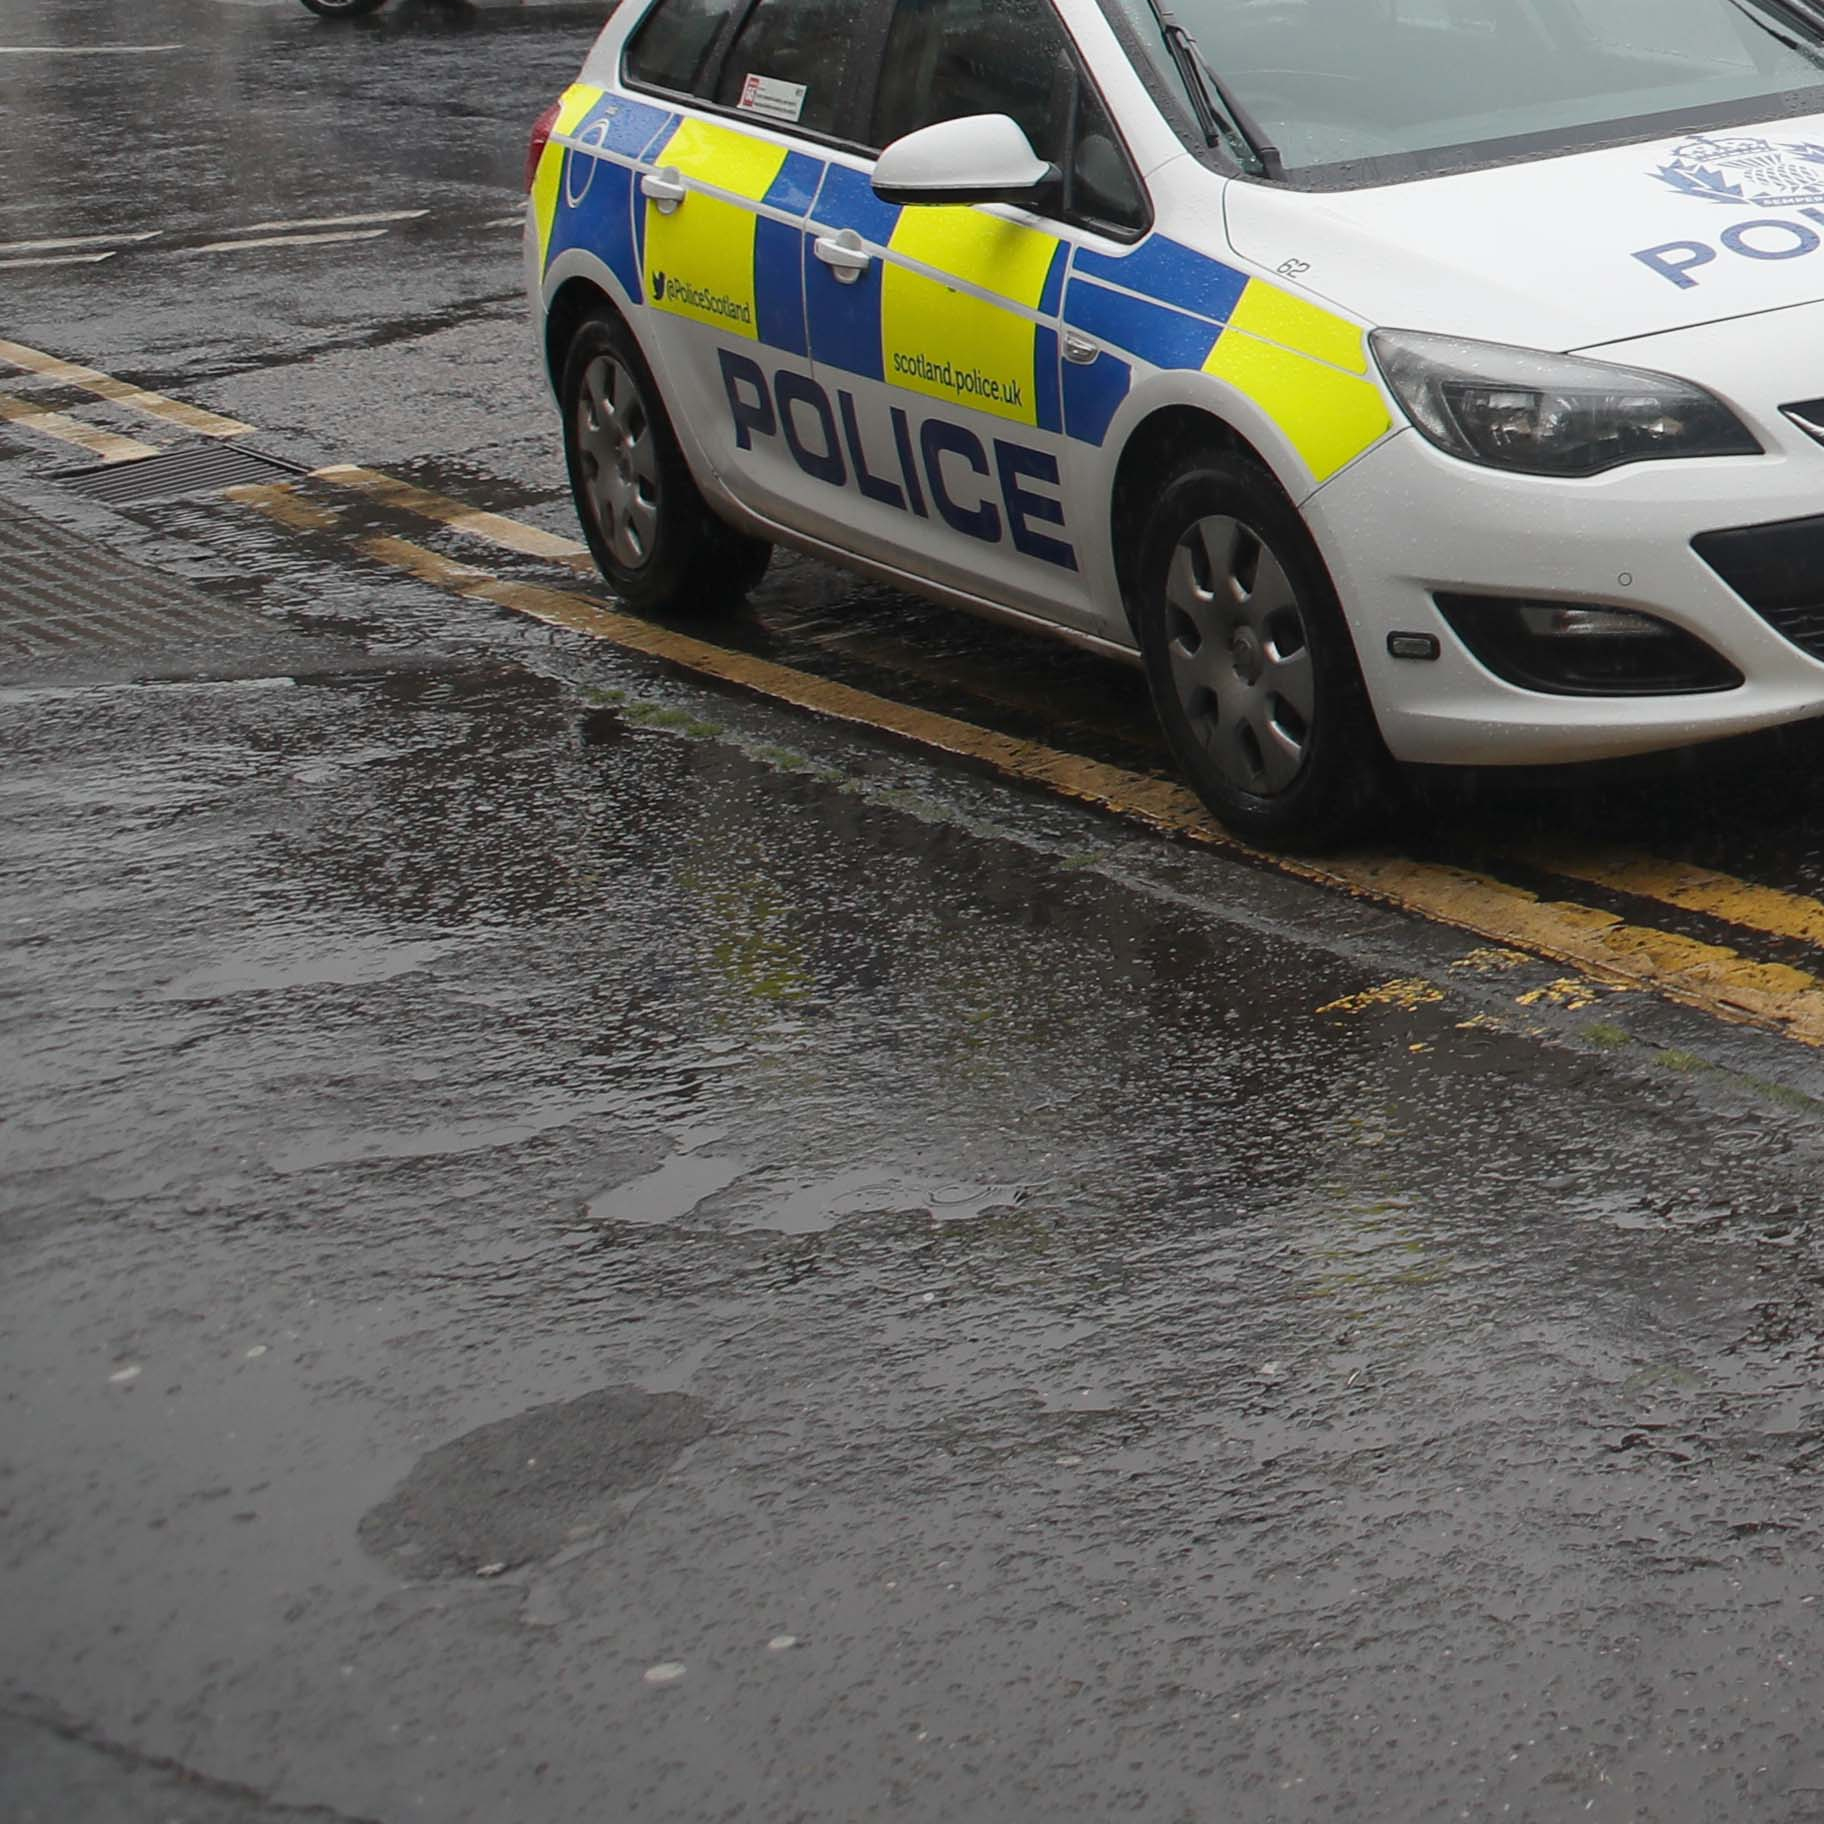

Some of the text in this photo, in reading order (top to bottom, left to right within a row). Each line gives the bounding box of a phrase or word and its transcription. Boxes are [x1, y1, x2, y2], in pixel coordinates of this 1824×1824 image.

[1276, 257, 1311, 279] 62
[667, 277, 752, 324] @PoliceScotland
[893, 352, 1023, 407] scotland.police.uk
[718, 348, 1080, 572] POLICE
